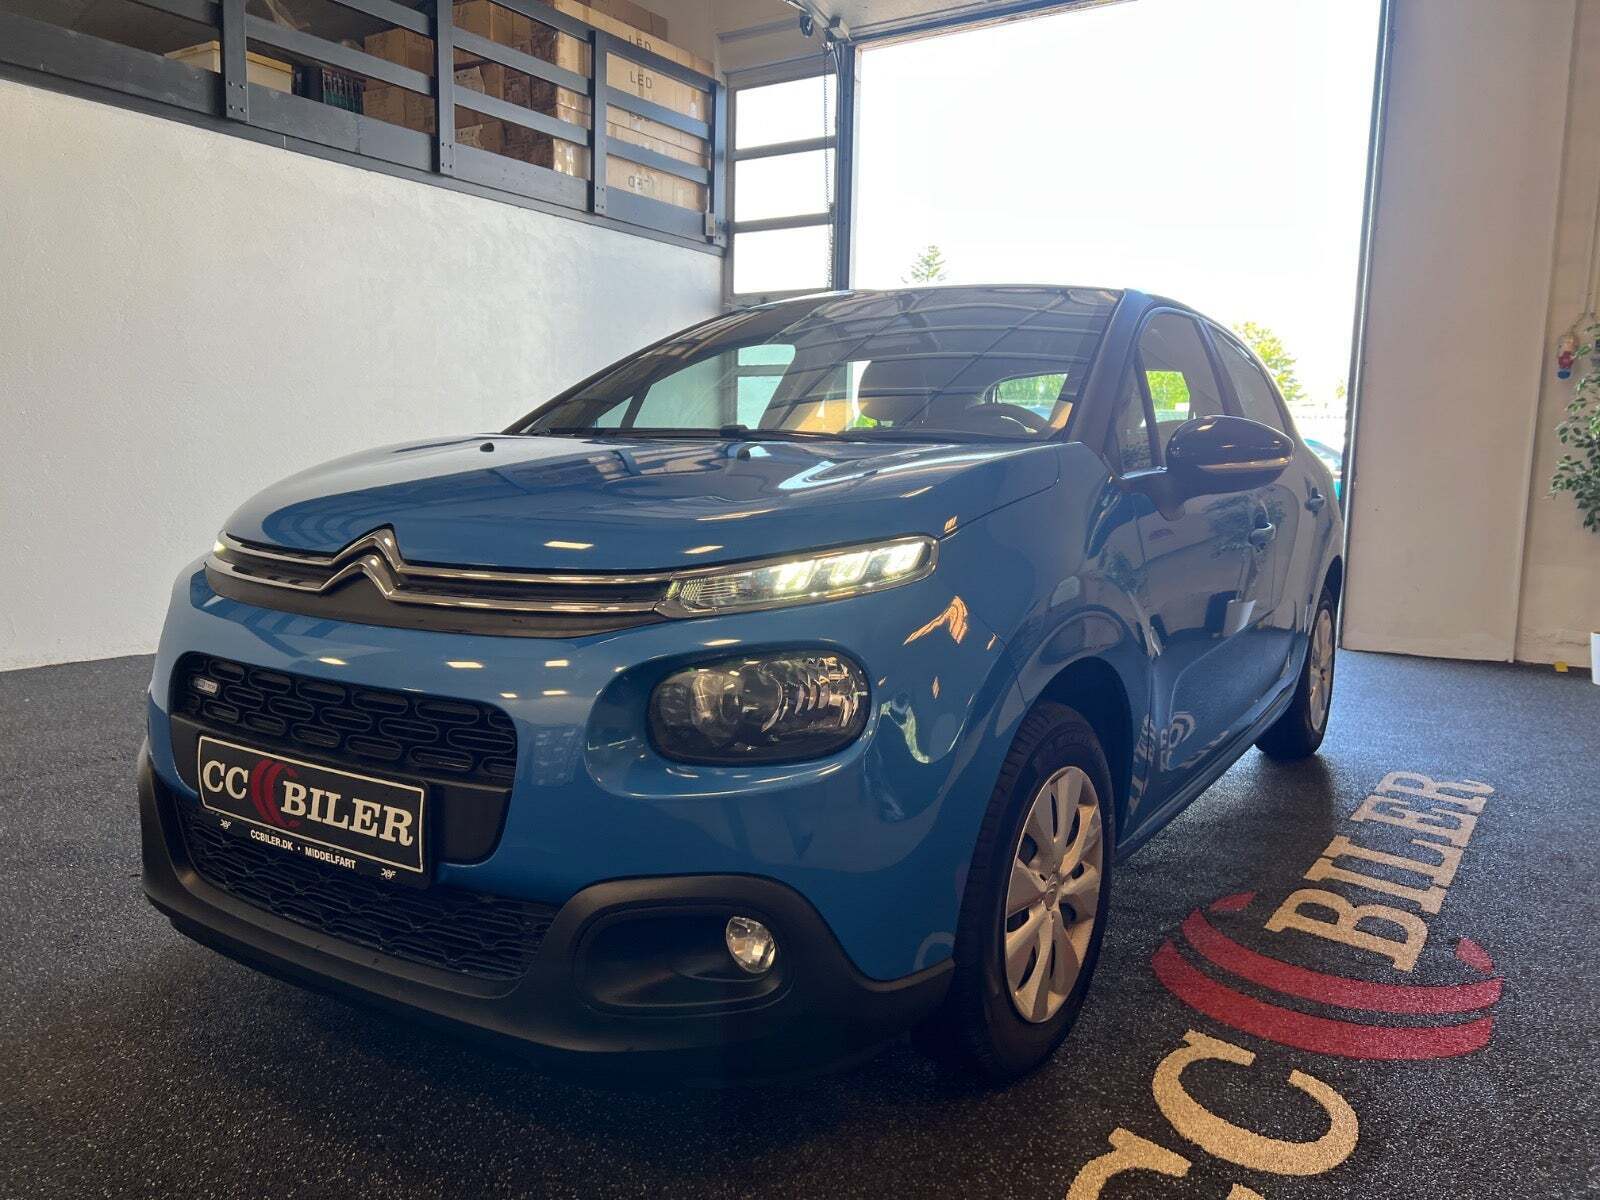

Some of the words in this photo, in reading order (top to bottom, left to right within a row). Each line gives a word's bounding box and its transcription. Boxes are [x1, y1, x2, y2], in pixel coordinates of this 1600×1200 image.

[630, 70, 653, 89] LED
[203, 760, 248, 800] CC
[280, 780, 414, 847] BILER
[250, 829, 294, 852] CCBILER.DK
[304, 846, 357, 870] MIDDELFART
[1264, 771, 1495, 972] BILER
